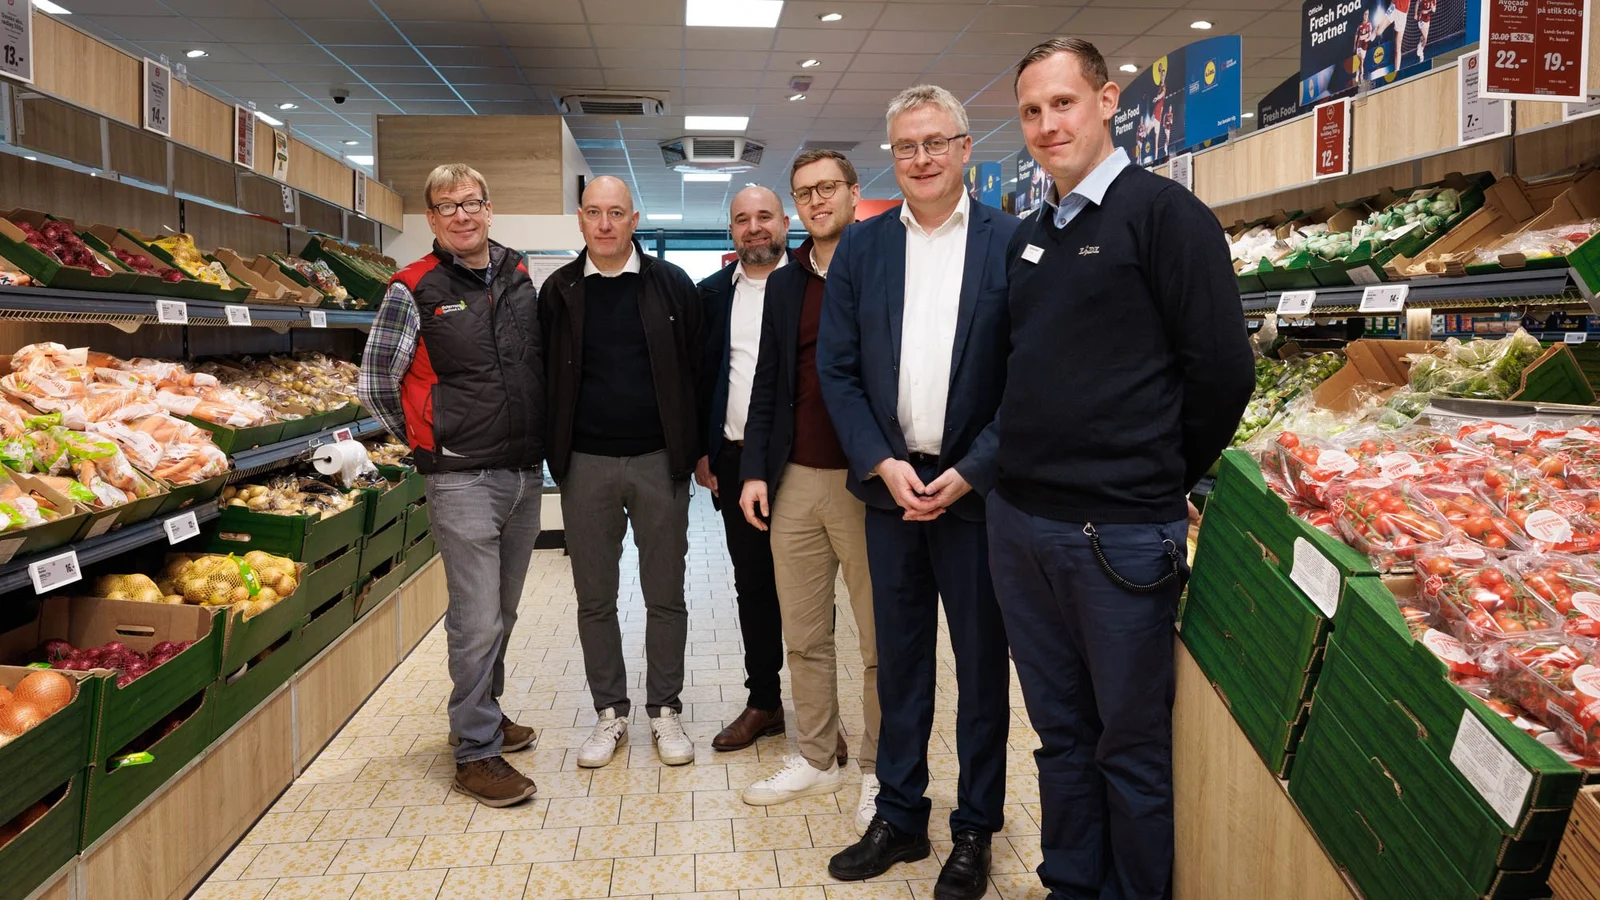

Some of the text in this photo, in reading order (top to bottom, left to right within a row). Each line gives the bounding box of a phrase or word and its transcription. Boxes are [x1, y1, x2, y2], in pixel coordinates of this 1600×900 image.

[1310, 0, 1362, 32] Fresh Food
[1537, 7, 1546, 15] på
[1312, 21, 1348, 47] Partner
[4, 44, 24, 67] 13.-
[1495, 50, 1528, 69] 22.-
[1543, 53, 1574, 71] 19.-
[1114, 111, 1128, 126] Fresh
[1127, 104, 1140, 120] Food
[1262, 102, 1297, 124] Fresh Food
[1467, 114, 1479, 128] 7.-
[1115, 121, 1134, 137] Partner
[1321, 150, 1339, 168] 12.-
